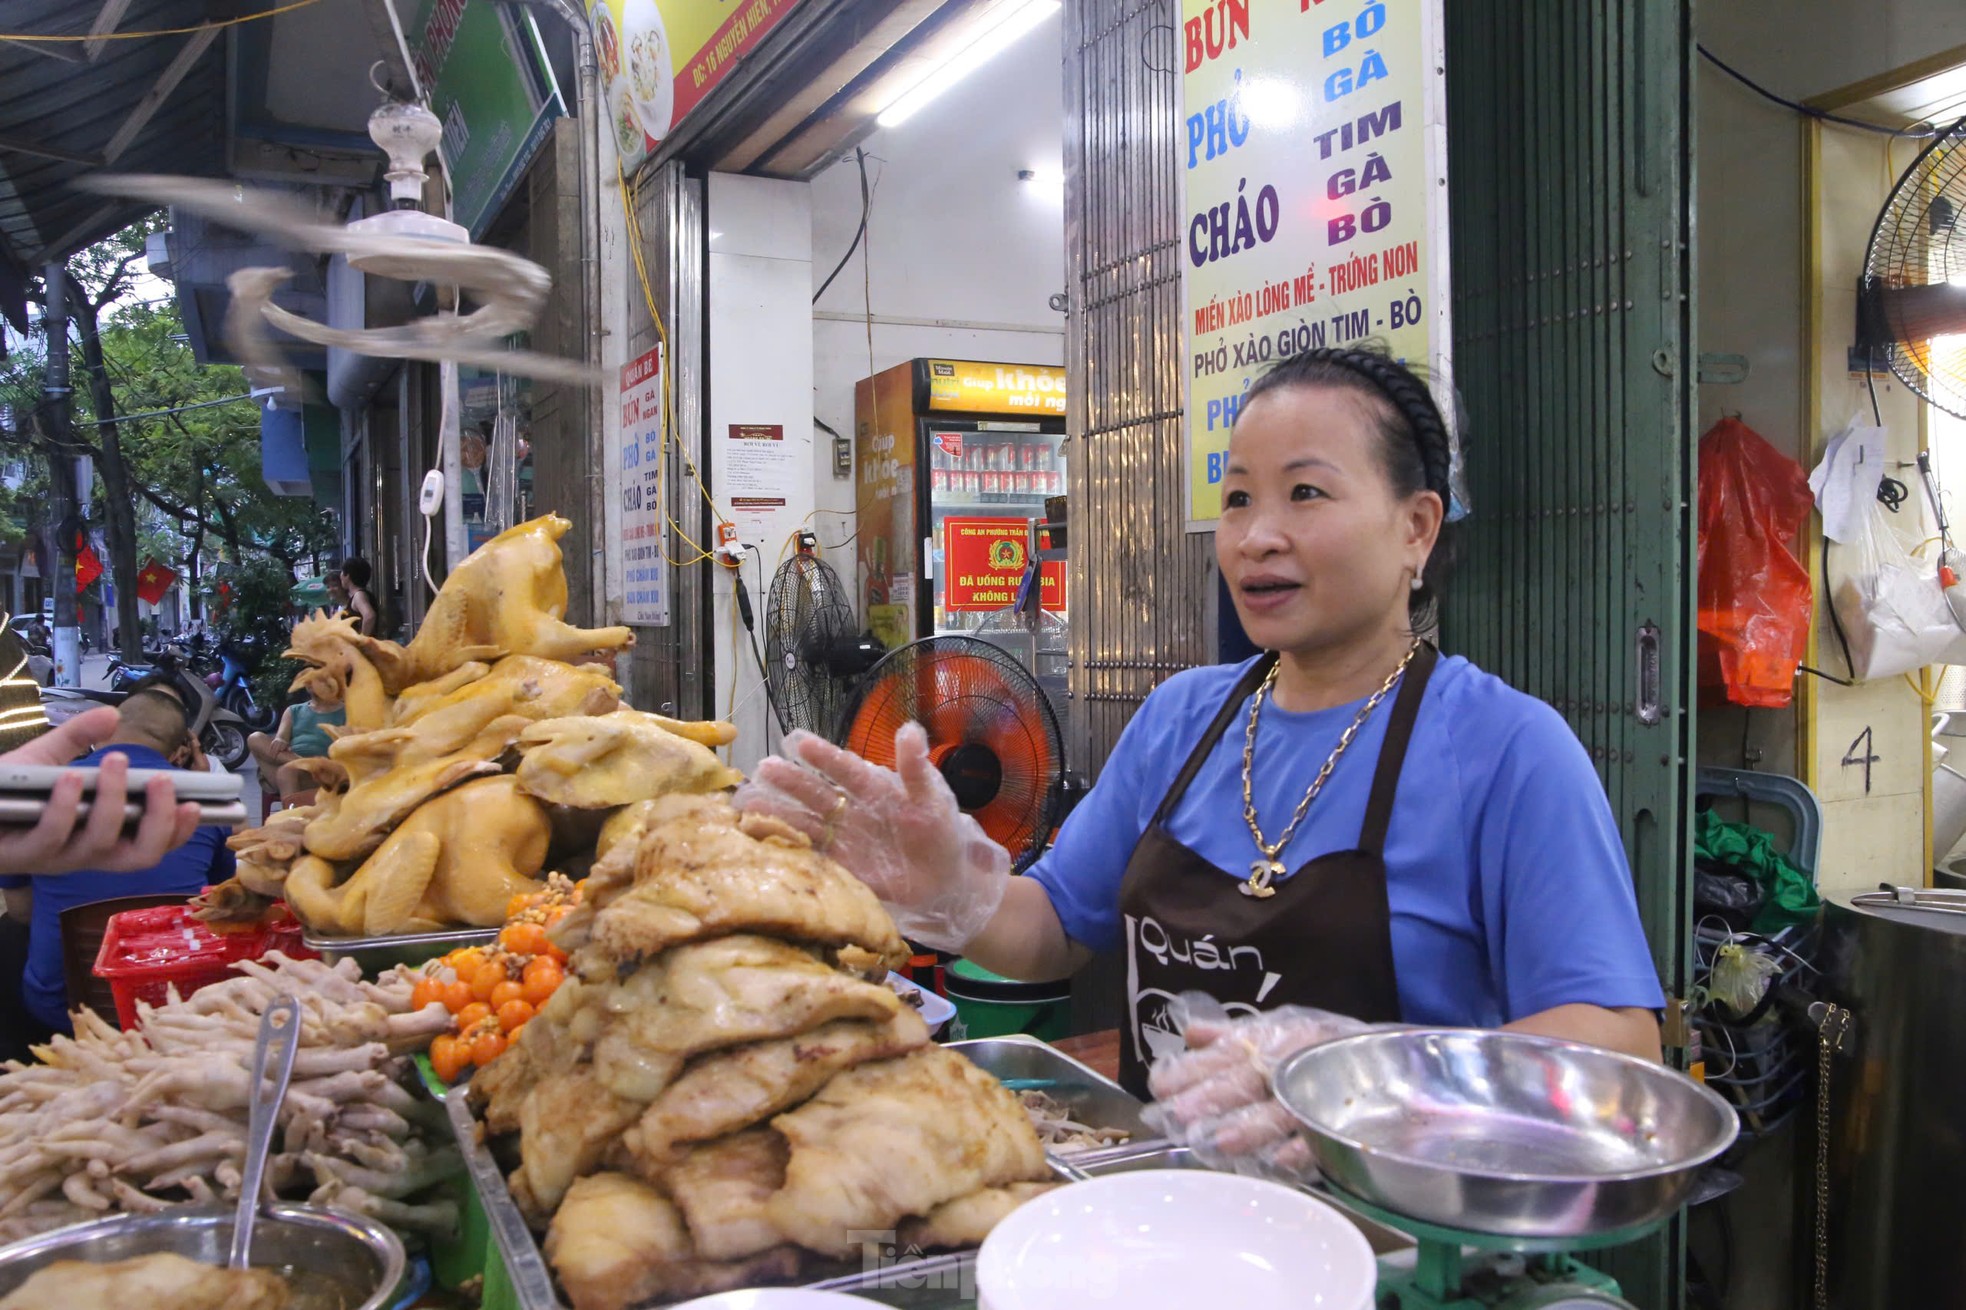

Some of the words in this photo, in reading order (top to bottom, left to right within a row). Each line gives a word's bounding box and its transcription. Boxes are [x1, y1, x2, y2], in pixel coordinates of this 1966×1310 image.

[1324, 49, 1389, 102] GÀ
[1313, 100, 1402, 160] TIM
[1327, 151, 1393, 200] GÀ
[1189, 177, 1280, 267] CHÁO
[1328, 196, 1391, 246] BÒ
[1228, 290, 1253, 326] XÀO
[1256, 281, 1290, 318] LÒNG
[1293, 262, 1315, 309] MỀ
[1328, 251, 1378, 297] TRỨNG
[1383, 241, 1418, 281] NON
[1194, 338, 1228, 379] PHỞ
[1233, 332, 1272, 369] XÀO
[1277, 318, 1326, 356] GIÒN
[1332, 308, 1370, 344] TIM
[1389, 289, 1422, 330] BÒ
[625, 362, 643, 387] QUÁN
[623, 394, 640, 429] BÚN
[643, 405, 658, 420] NGAN
[623, 480, 641, 513] CHÁO
[644, 469, 659, 482] TIM
[959, 575, 974, 586] ĐÃ
[977, 573, 1005, 586] UỐNG
[972, 589, 1008, 602] KHÔNG
[1841, 725, 1881, 794] 4
[1140, 916, 1263, 968] Quán
